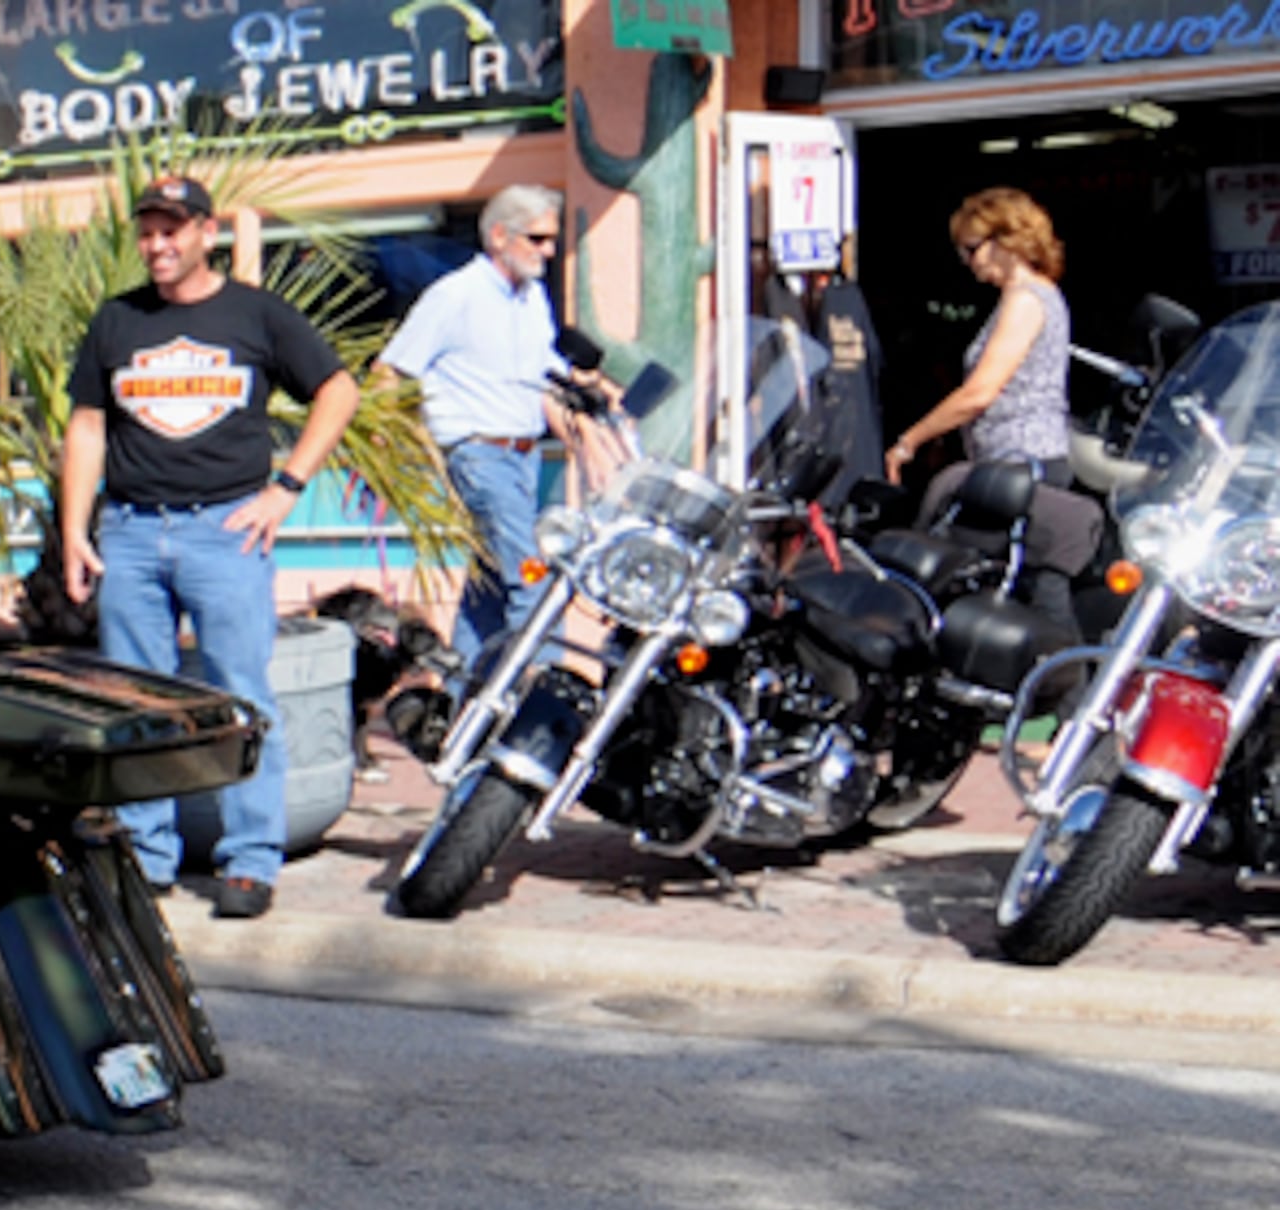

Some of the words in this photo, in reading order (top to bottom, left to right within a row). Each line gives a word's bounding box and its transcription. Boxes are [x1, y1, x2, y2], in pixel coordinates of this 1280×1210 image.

[231, 9, 324, 62] OF
[19, 77, 196, 145] BODY
[224, 37, 556, 120] JEWELRY
